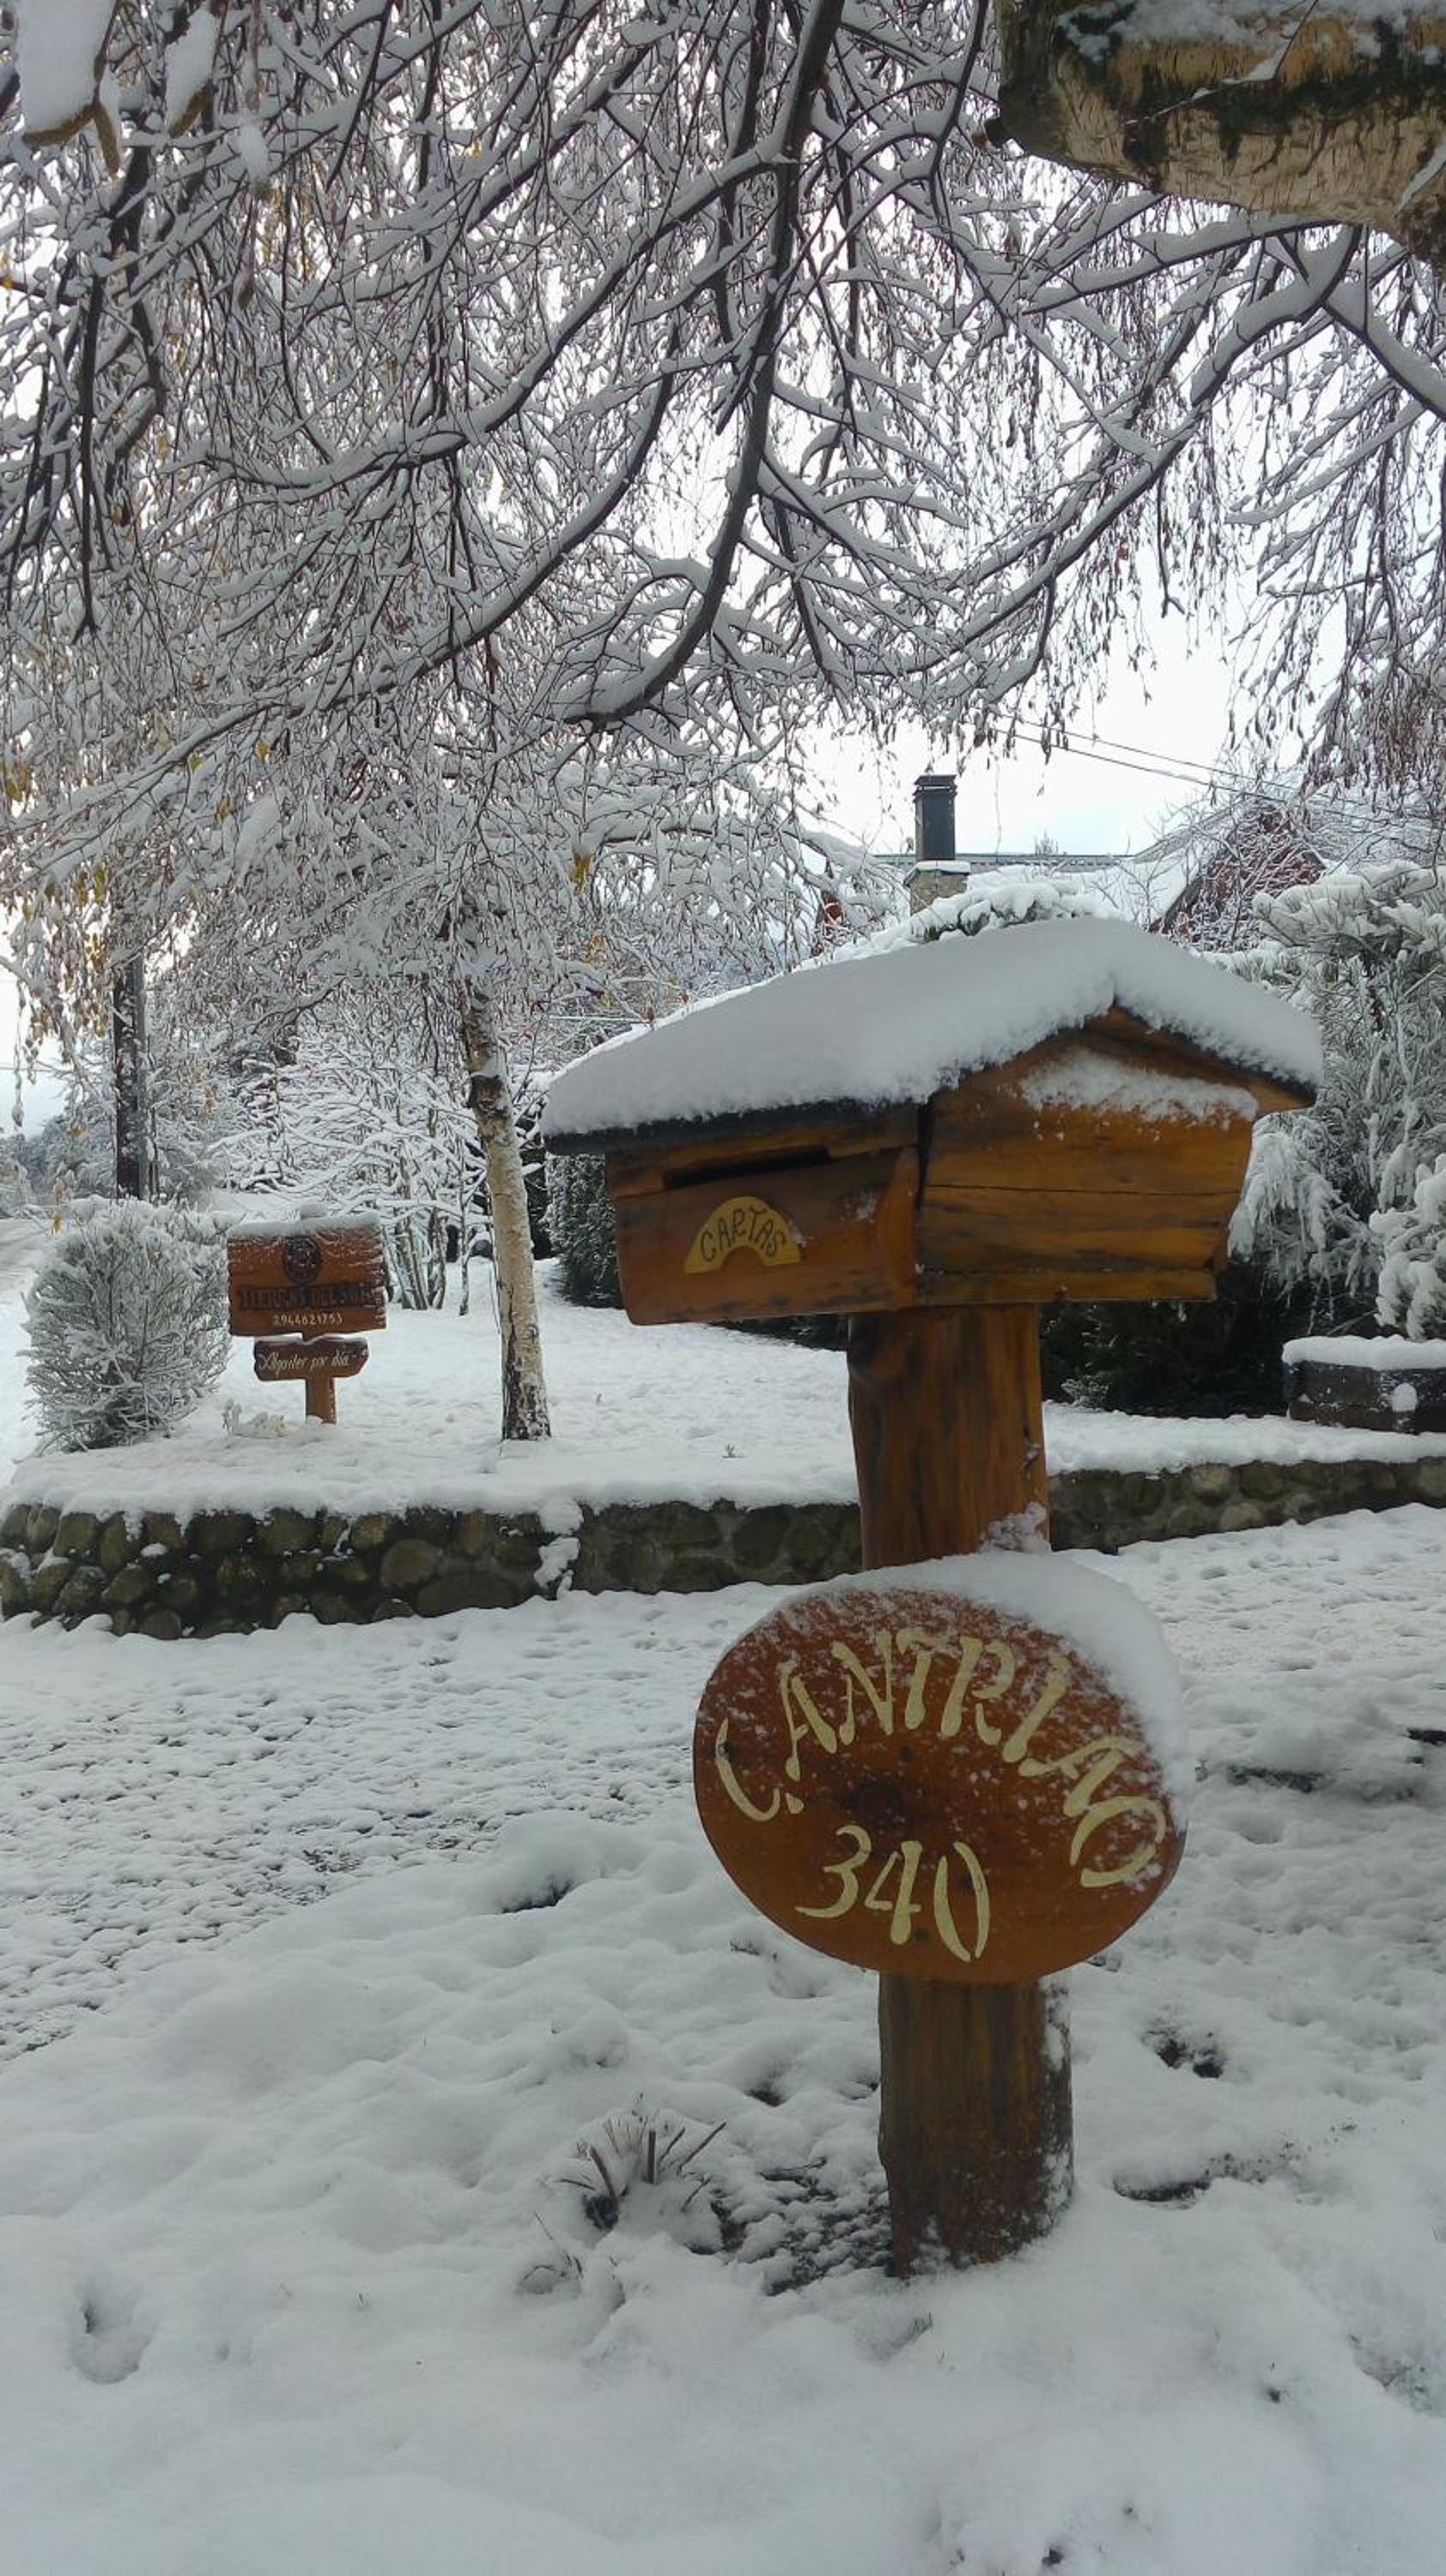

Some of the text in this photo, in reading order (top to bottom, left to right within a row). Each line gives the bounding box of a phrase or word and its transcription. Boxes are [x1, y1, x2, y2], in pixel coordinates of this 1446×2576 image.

[700, 1205, 787, 1262] CARTAS
[310, 1358, 329, 1370] por
[795, 1825, 991, 1964] 340
